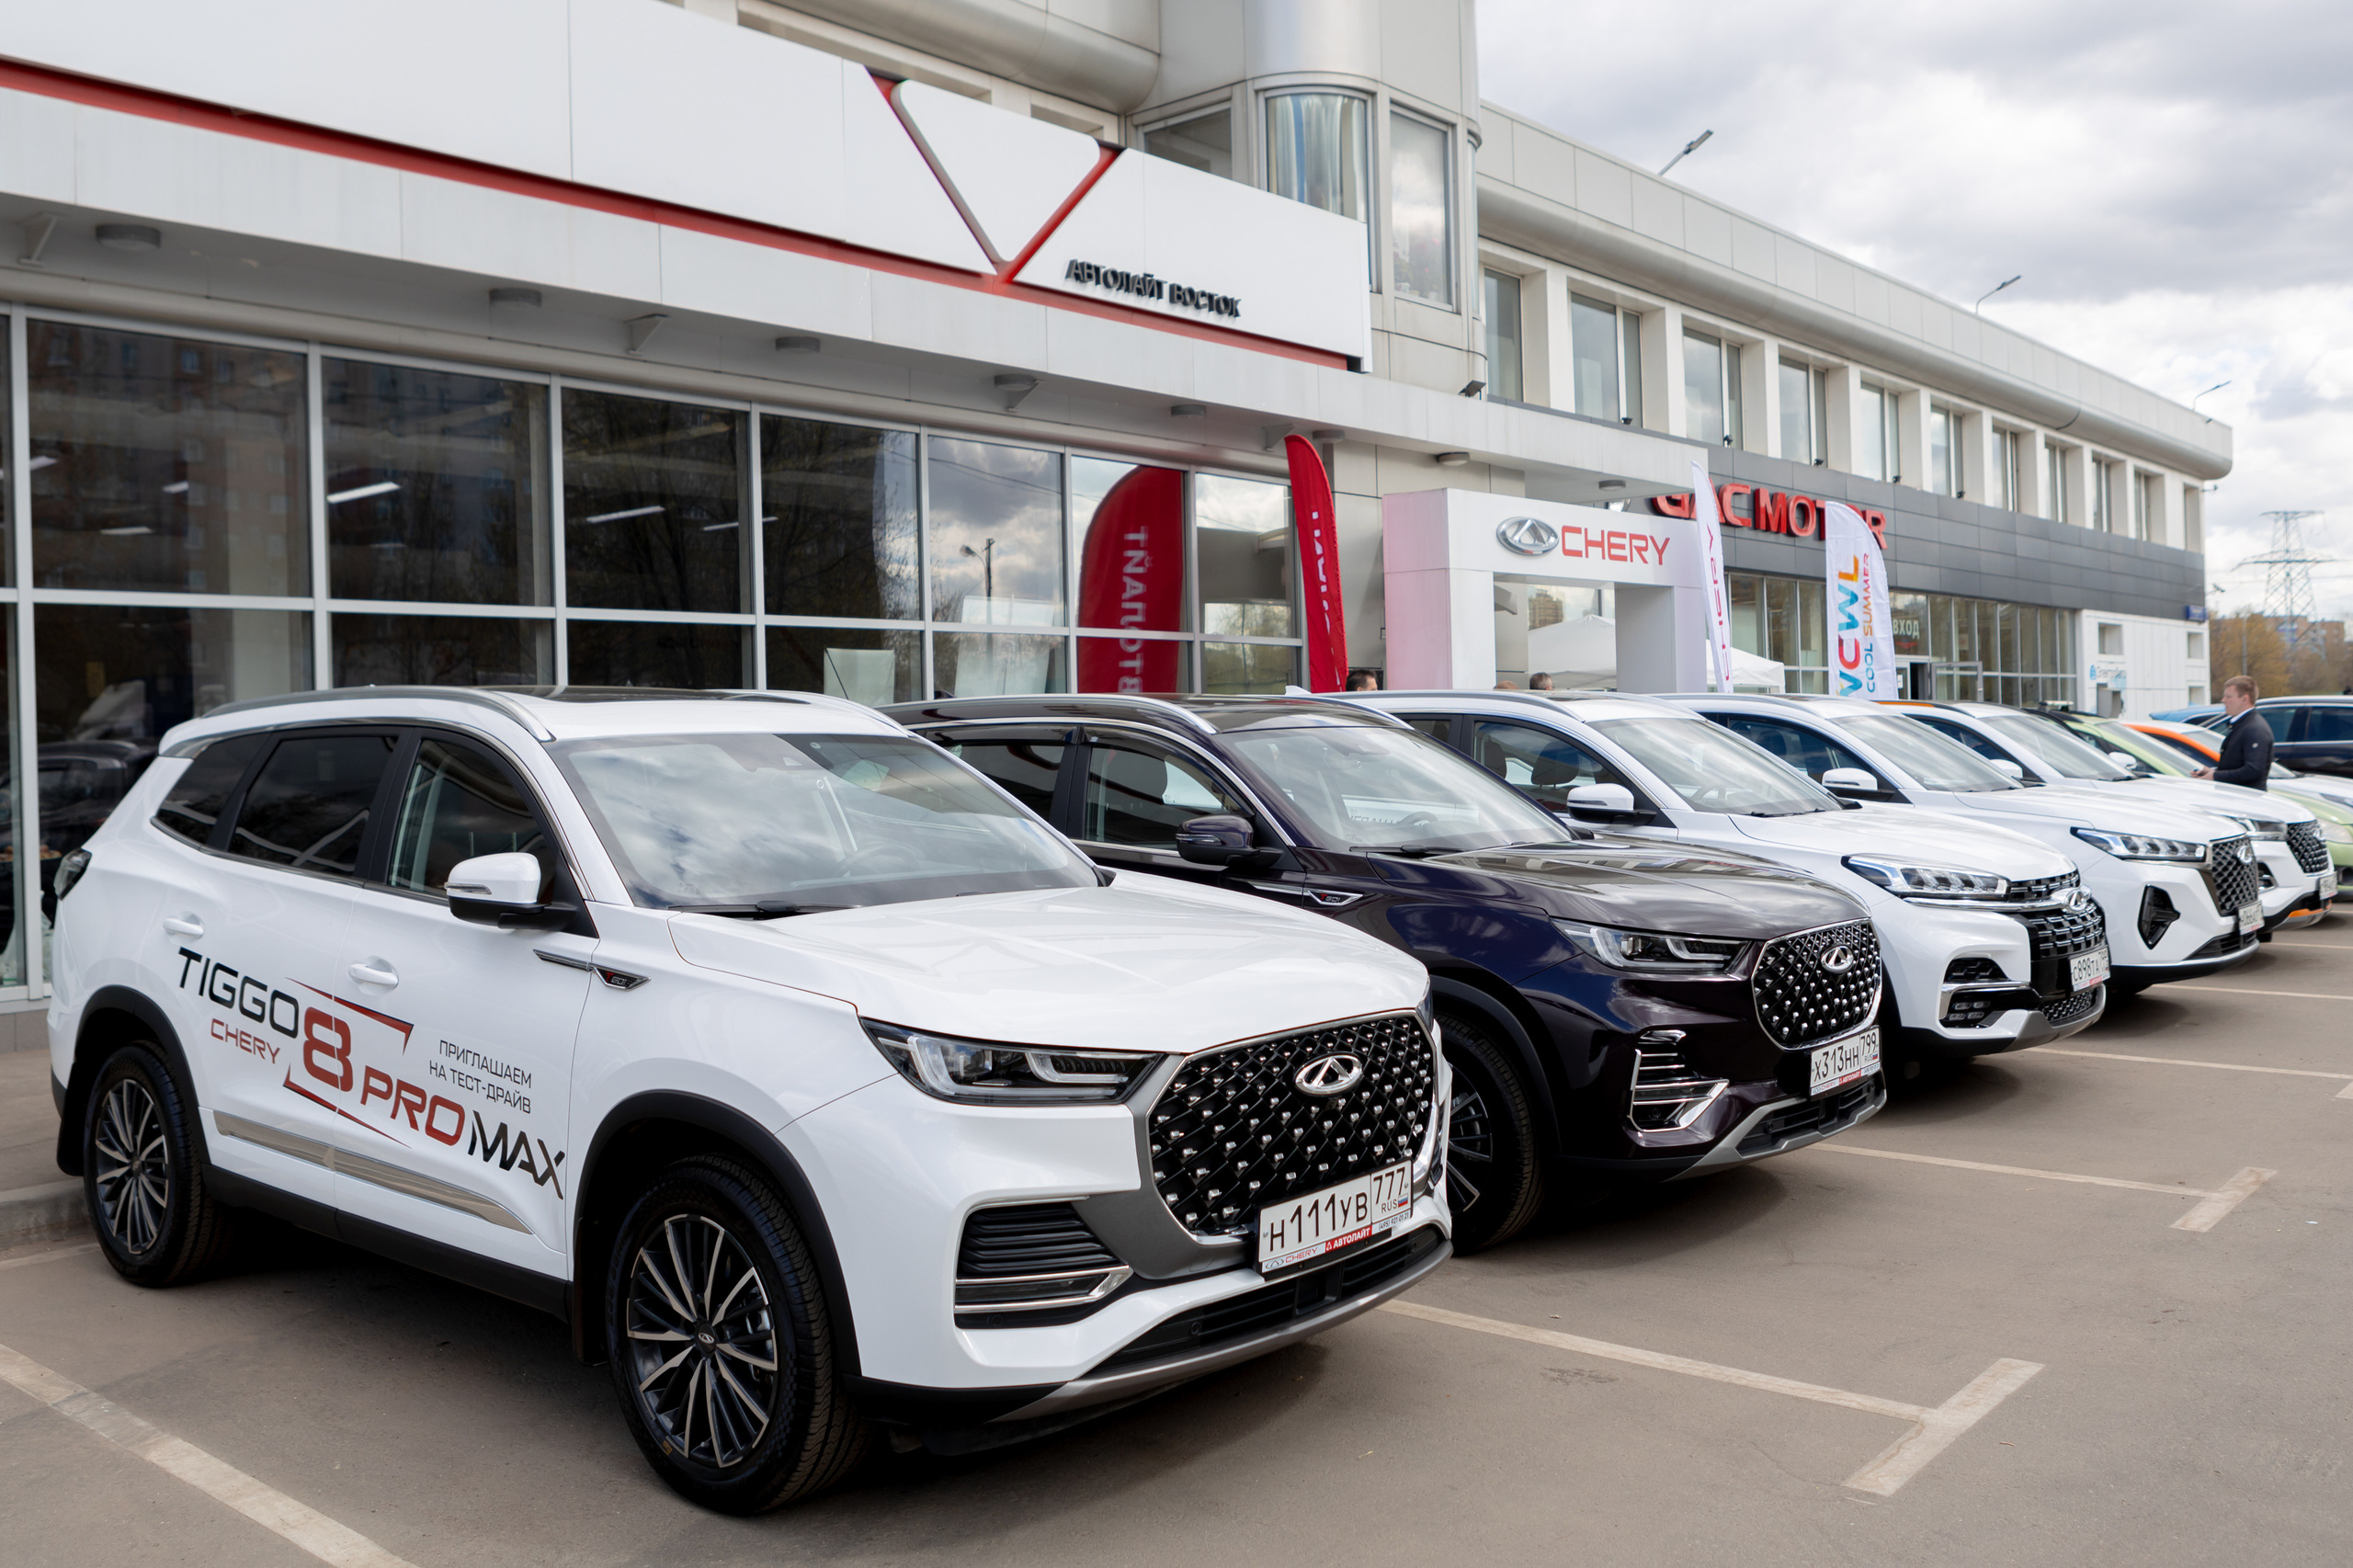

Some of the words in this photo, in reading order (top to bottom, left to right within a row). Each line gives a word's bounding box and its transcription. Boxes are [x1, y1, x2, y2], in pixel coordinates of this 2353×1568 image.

[1065, 259, 1167, 300] АВТОЛАЙТ
[1169, 283, 1242, 317] ВОСТОК
[1755, 487, 1888, 550] MOTR
[1562, 525, 1671, 565] CHERY
[1862, 553, 1873, 637] SUMMER
[1893, 619, 1920, 640] ВХОД
[1864, 642, 1875, 693] COOL
[210, 1018, 280, 1064] CHERY
[439, 1040, 532, 1088] ПРИГЛАШАЕМ
[1860, 1032, 1877, 1056] 799
[178, 947, 299, 1039] TIGGO
[303, 1006, 353, 1092] 8
[360, 1064, 465, 1146] PRO
[468, 1110, 565, 1199] MAX
[429, 1061, 448, 1082] НА
[449, 1069, 532, 1115] ТЕСТ-ДРАЙВ
[1373, 1166, 1405, 1205] 777
[1381, 1199, 1398, 1213] RUS
[1285, 1247, 1318, 1263] CHERY
[1334, 1228, 1370, 1249] АВТОЛАЙТ
